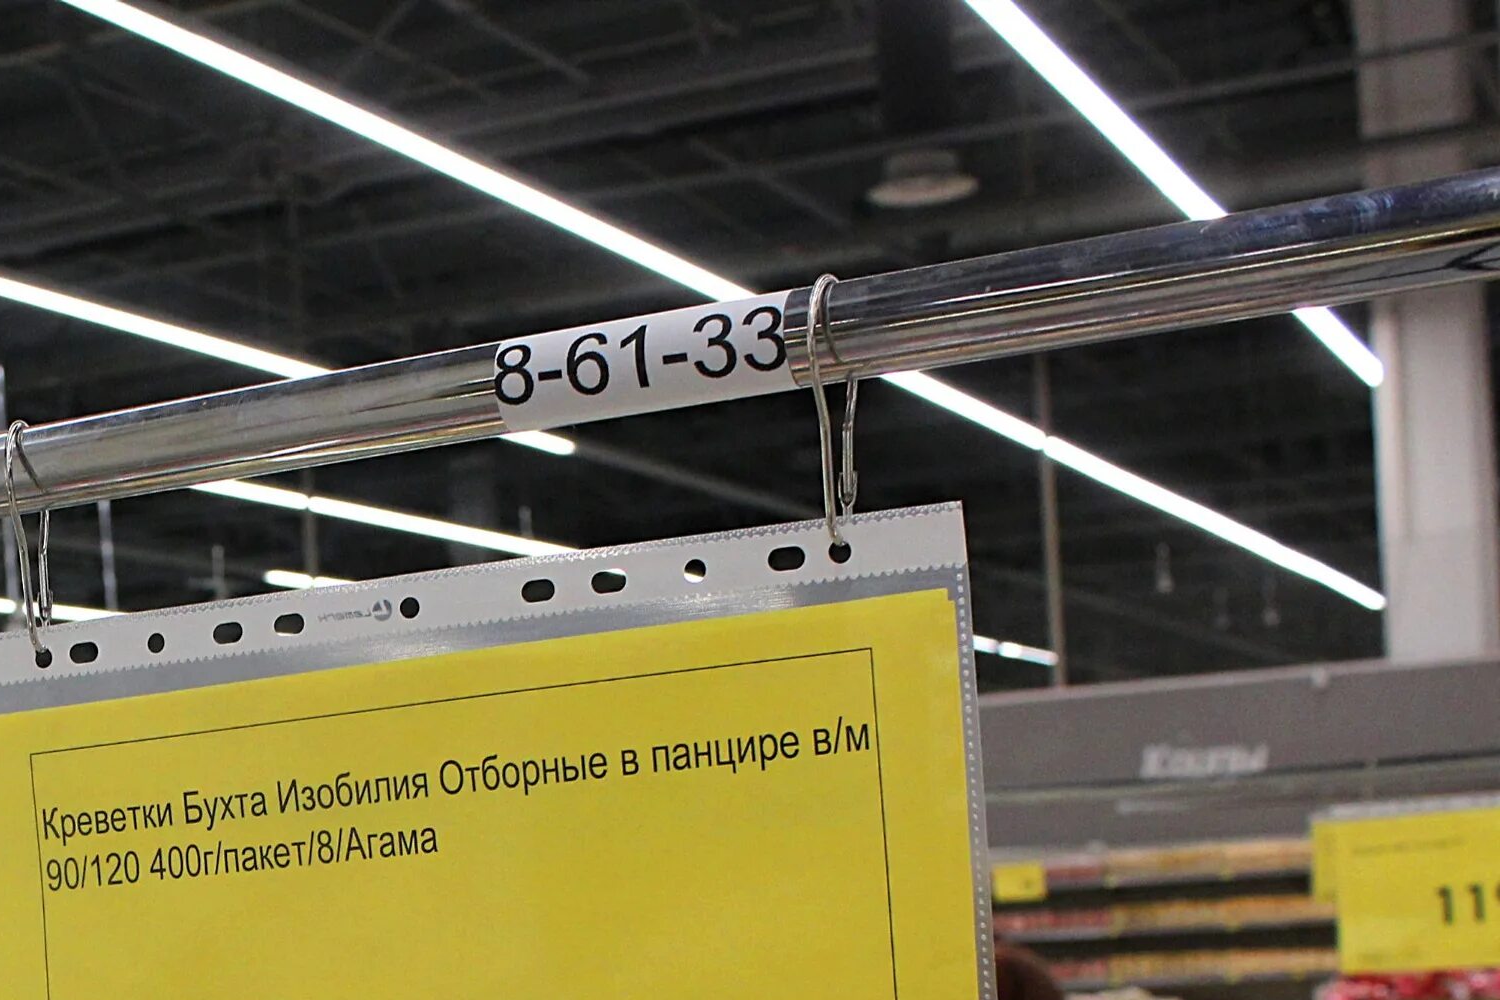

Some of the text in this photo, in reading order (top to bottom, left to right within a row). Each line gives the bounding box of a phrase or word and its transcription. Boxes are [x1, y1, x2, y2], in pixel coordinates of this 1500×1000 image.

[494, 305, 788, 406] 8-61-33
[42, 715, 871, 846] Креветки Бухта Изобилия Отборные в панцире в/м
[46, 826, 439, 892] 90/120 400г/пакет/8/Агама
[1437, 879, 1500, 926] 11
